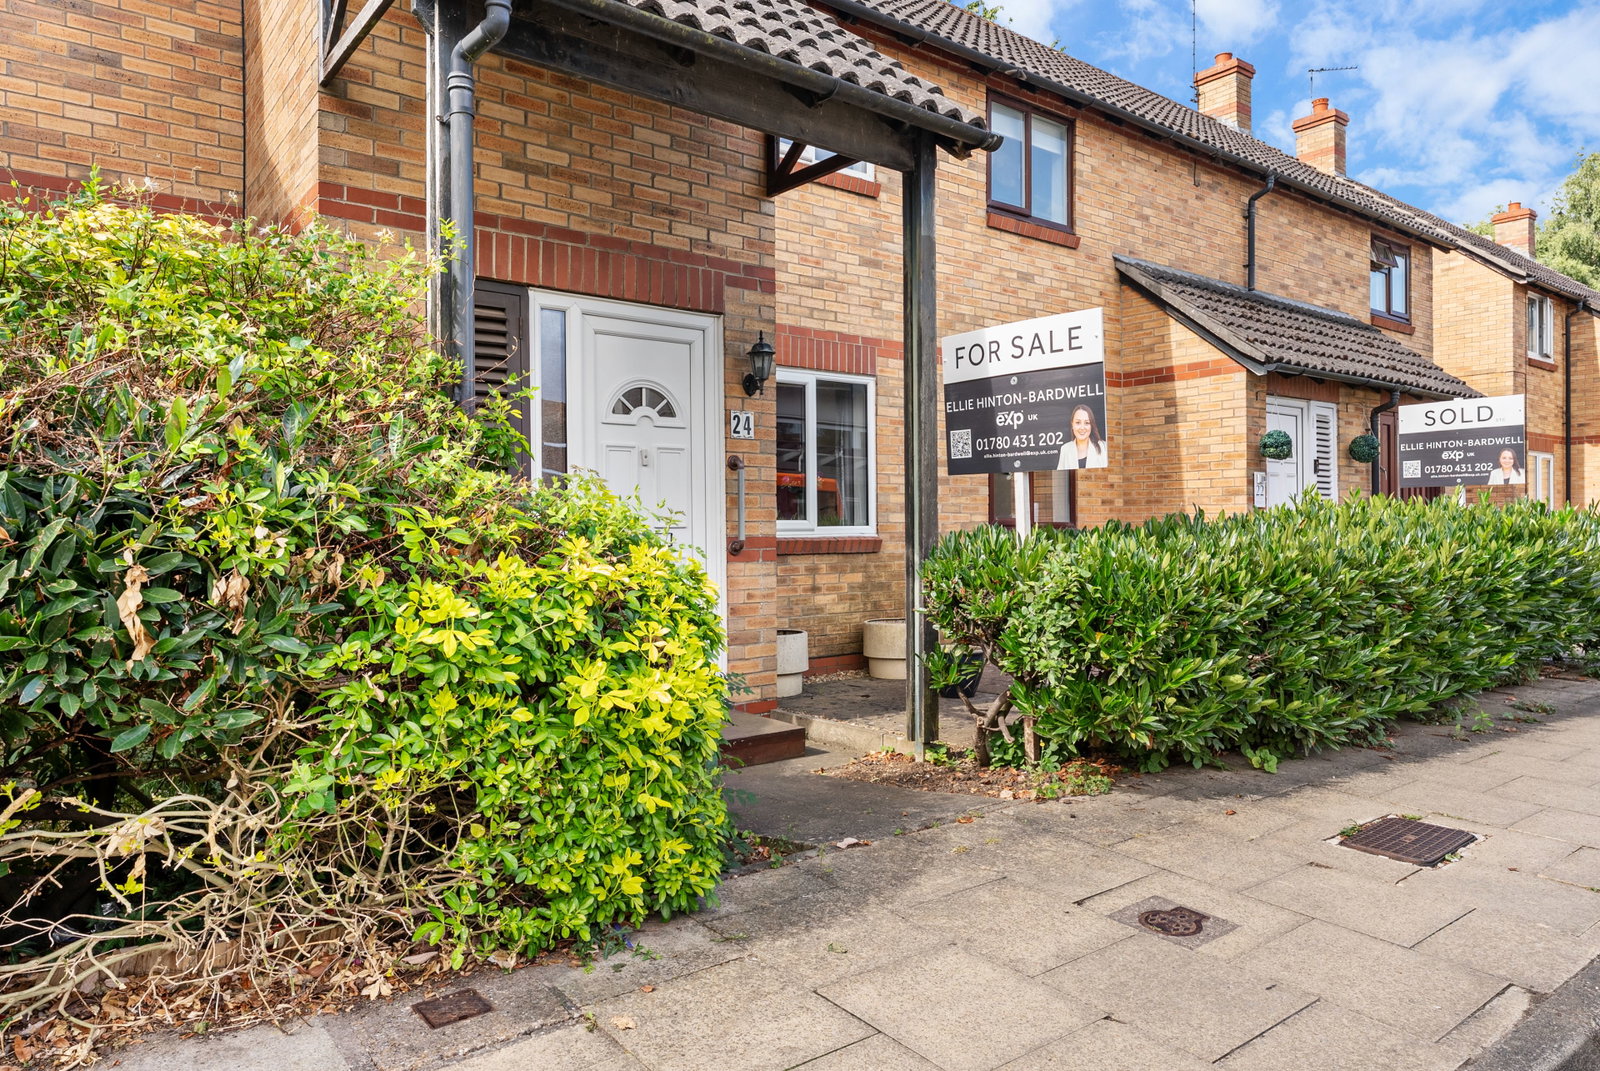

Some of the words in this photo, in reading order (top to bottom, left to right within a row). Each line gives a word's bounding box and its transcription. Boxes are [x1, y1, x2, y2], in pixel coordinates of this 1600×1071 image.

[955, 340, 1001, 369] FOR
[1011, 325, 1083, 360] SALE
[946, 398, 975, 413] ELLIE
[976, 383, 1104, 409] HINTON-BARDWELL
[732, 414, 752, 436] 24
[1027, 413, 1039, 421] UK
[1424, 405, 1494, 427] SOLD
[976, 435, 1011, 451] 01780
[1012, 434, 1036, 447] 431
[1038, 431, 1064, 446] 202
[1400, 442, 1425, 452] ELLIE
[1426, 436, 1524, 450] HINTON-BARDWELL
[1424, 464, 1453, 474] 01780
[1454, 463, 1473, 473] 431
[1474, 462, 1494, 472] 202
